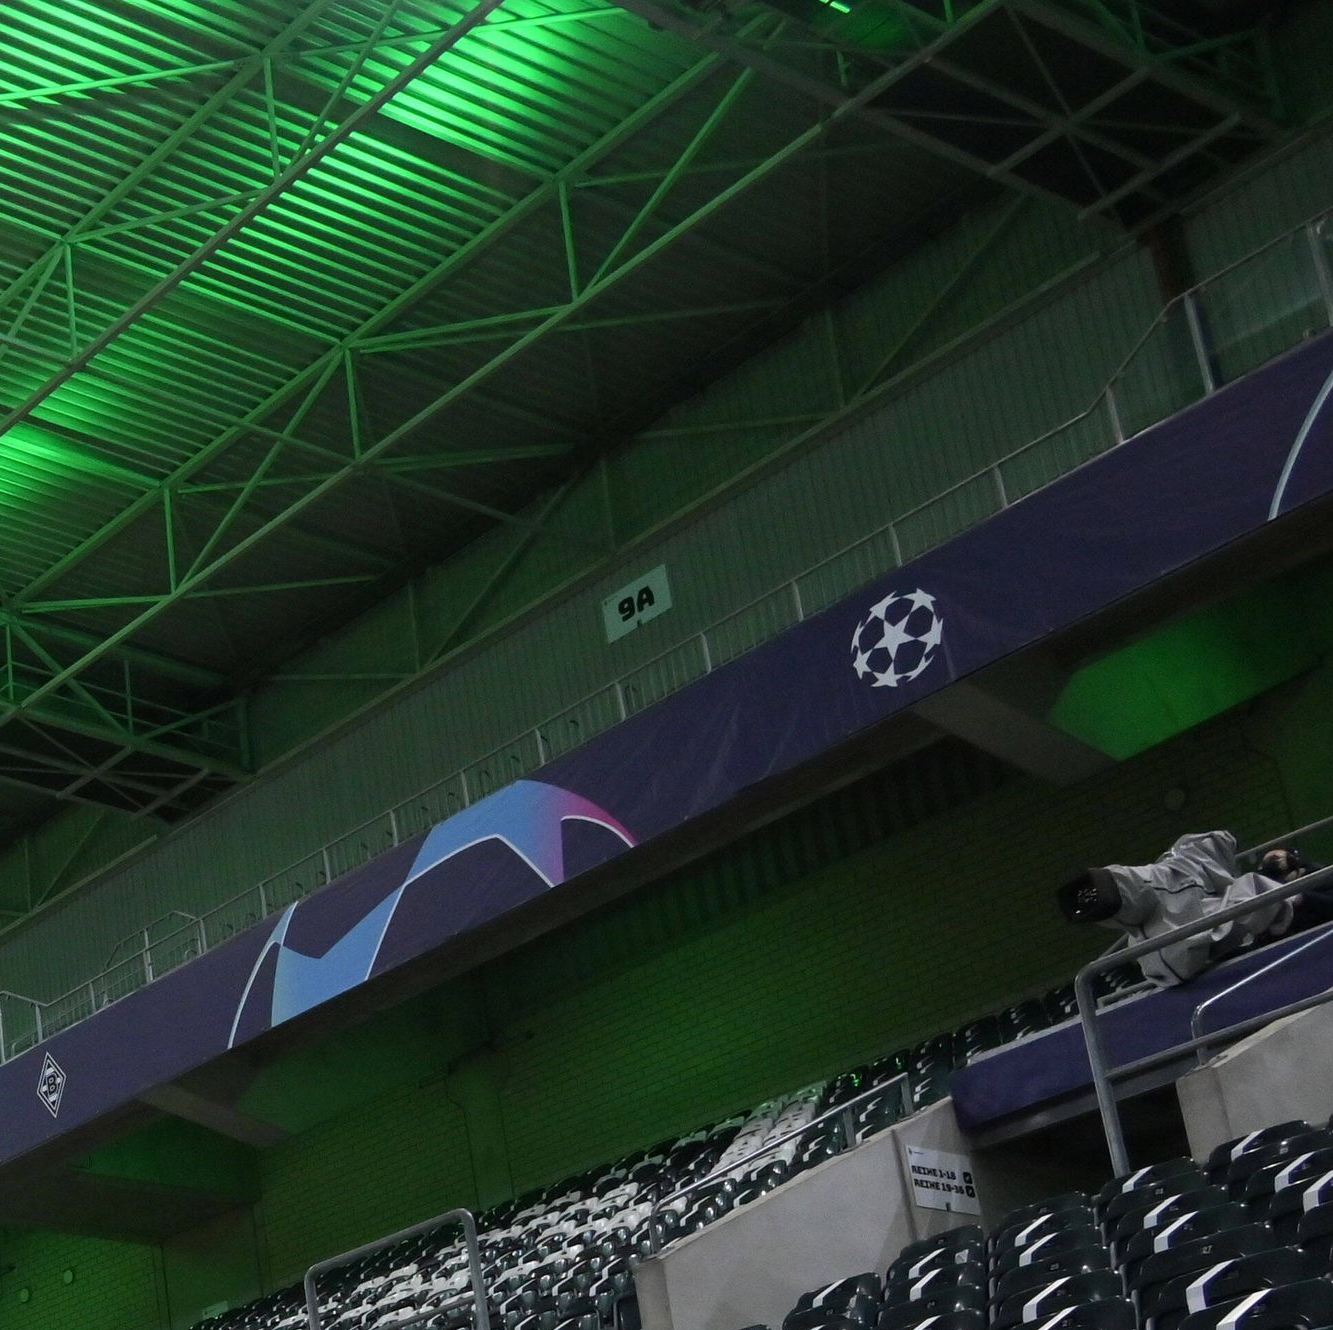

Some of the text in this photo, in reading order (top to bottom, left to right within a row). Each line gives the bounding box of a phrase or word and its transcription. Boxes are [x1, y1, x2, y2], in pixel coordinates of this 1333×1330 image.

[618, 585, 655, 622] 9A
[911, 1165, 938, 1178] REIHE
[914, 1178, 941, 1191] REIHE
